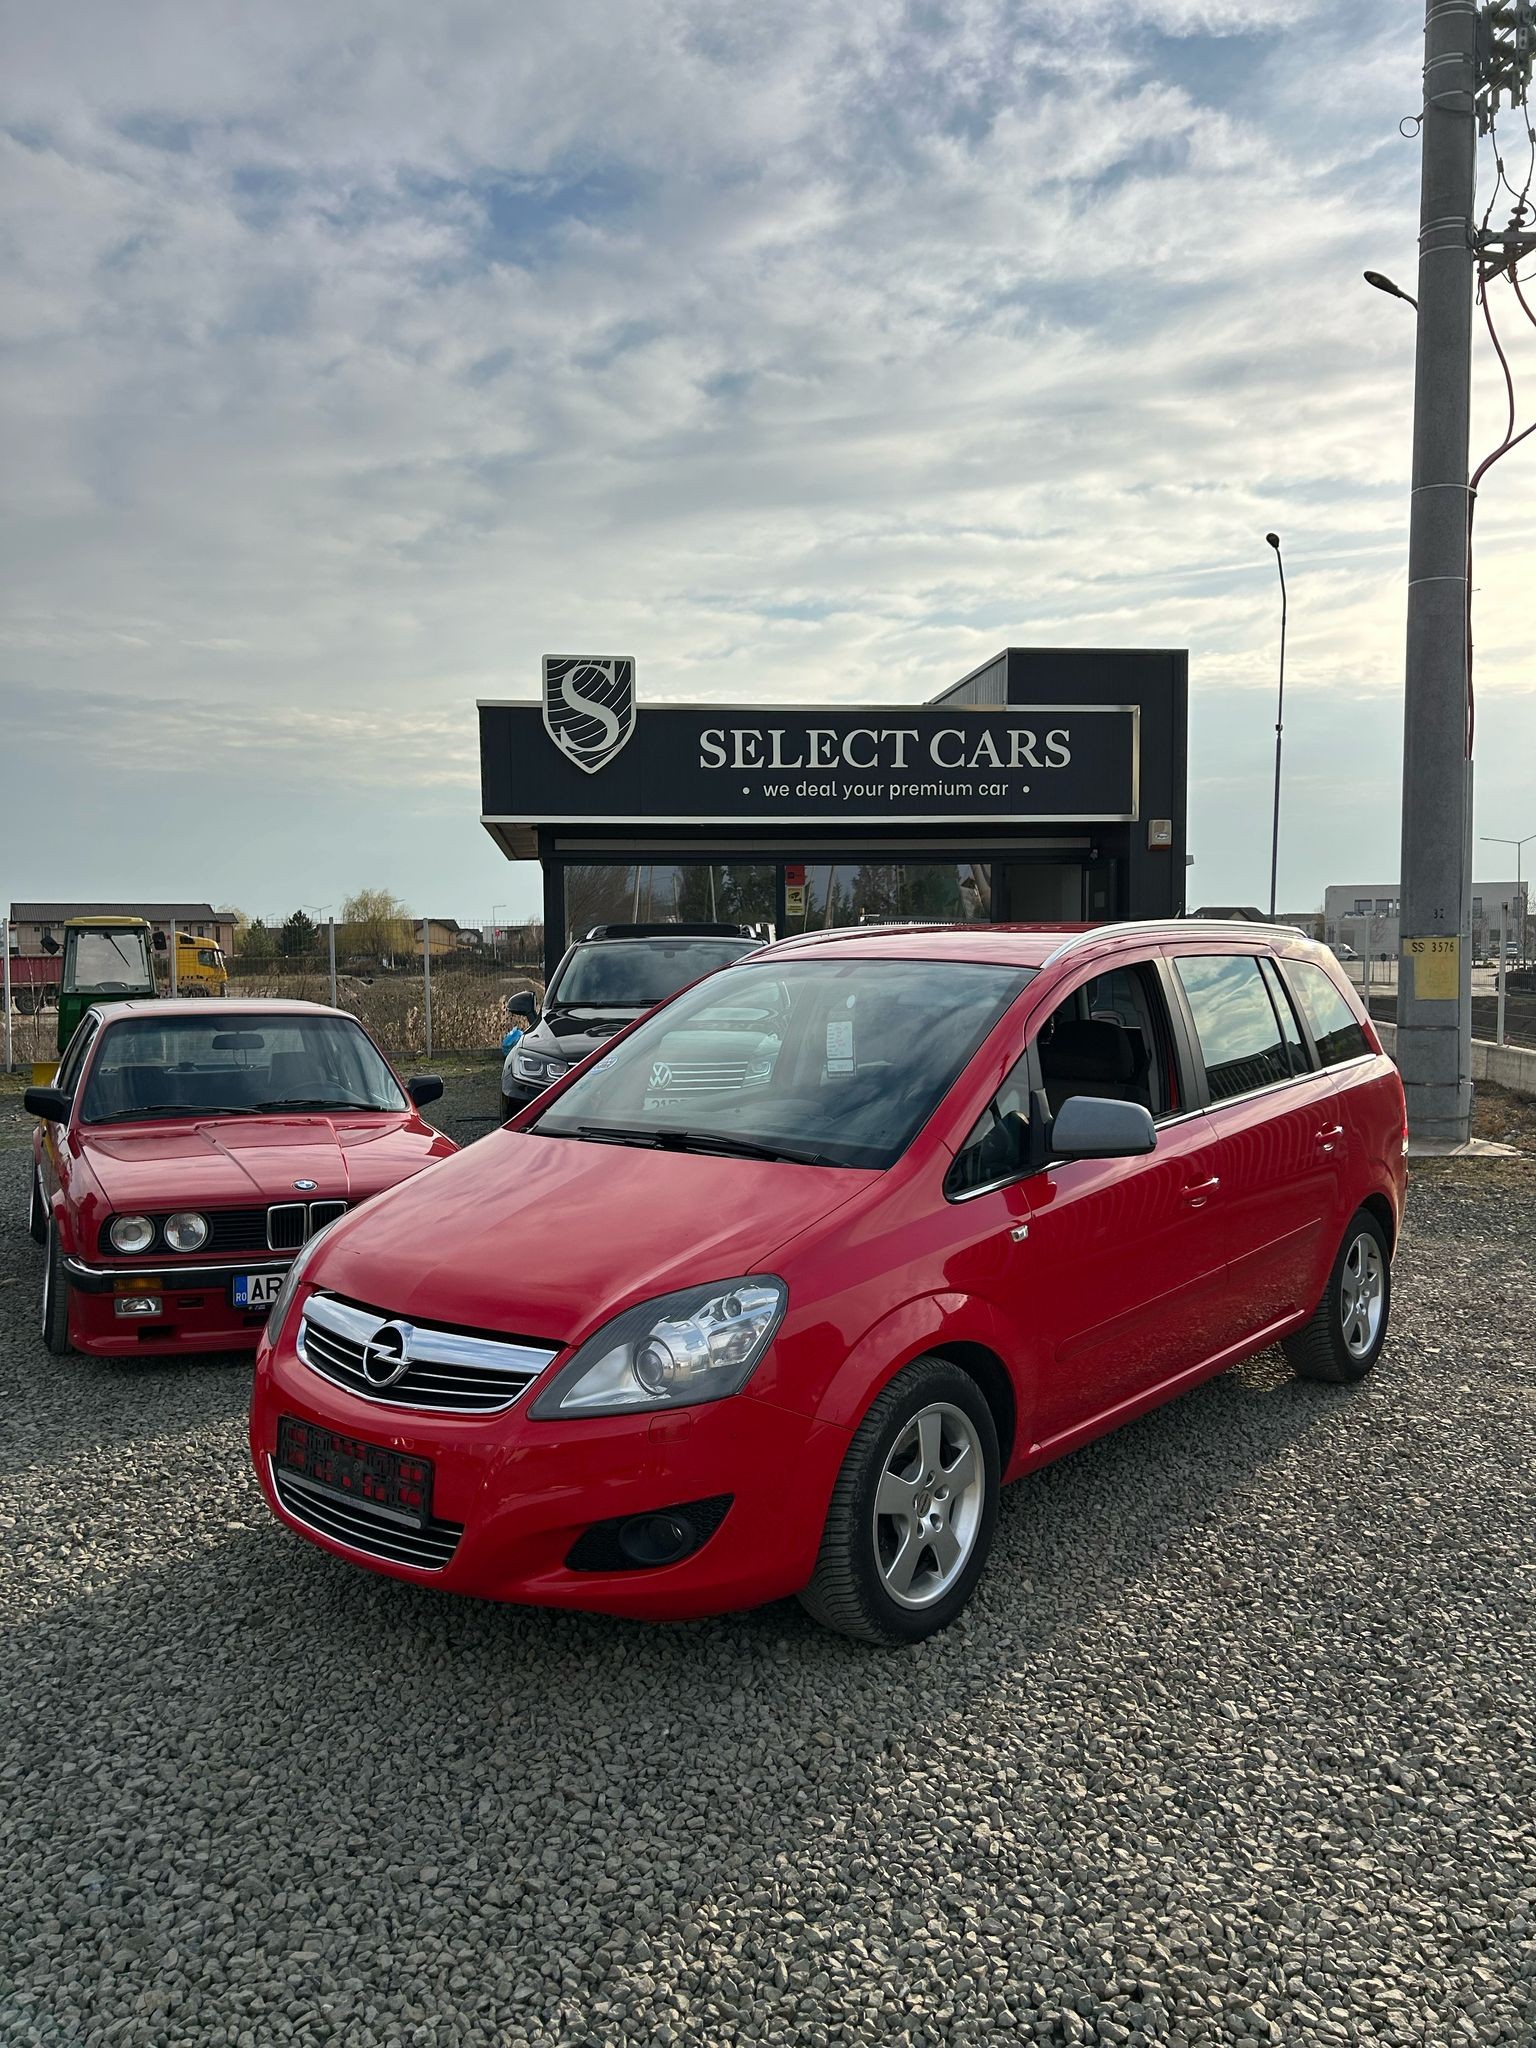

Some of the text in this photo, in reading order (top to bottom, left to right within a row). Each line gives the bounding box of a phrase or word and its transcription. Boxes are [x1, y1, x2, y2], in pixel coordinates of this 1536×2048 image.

[561, 660, 619, 752] S
[700, 729, 1071, 768] SELECT CARS
[763, 780, 1009, 800] we deal your premium car
[1412, 942, 1454, 952] SS 3576
[236, 1292, 247, 1302] RO
[251, 1277, 284, 1301] AR
